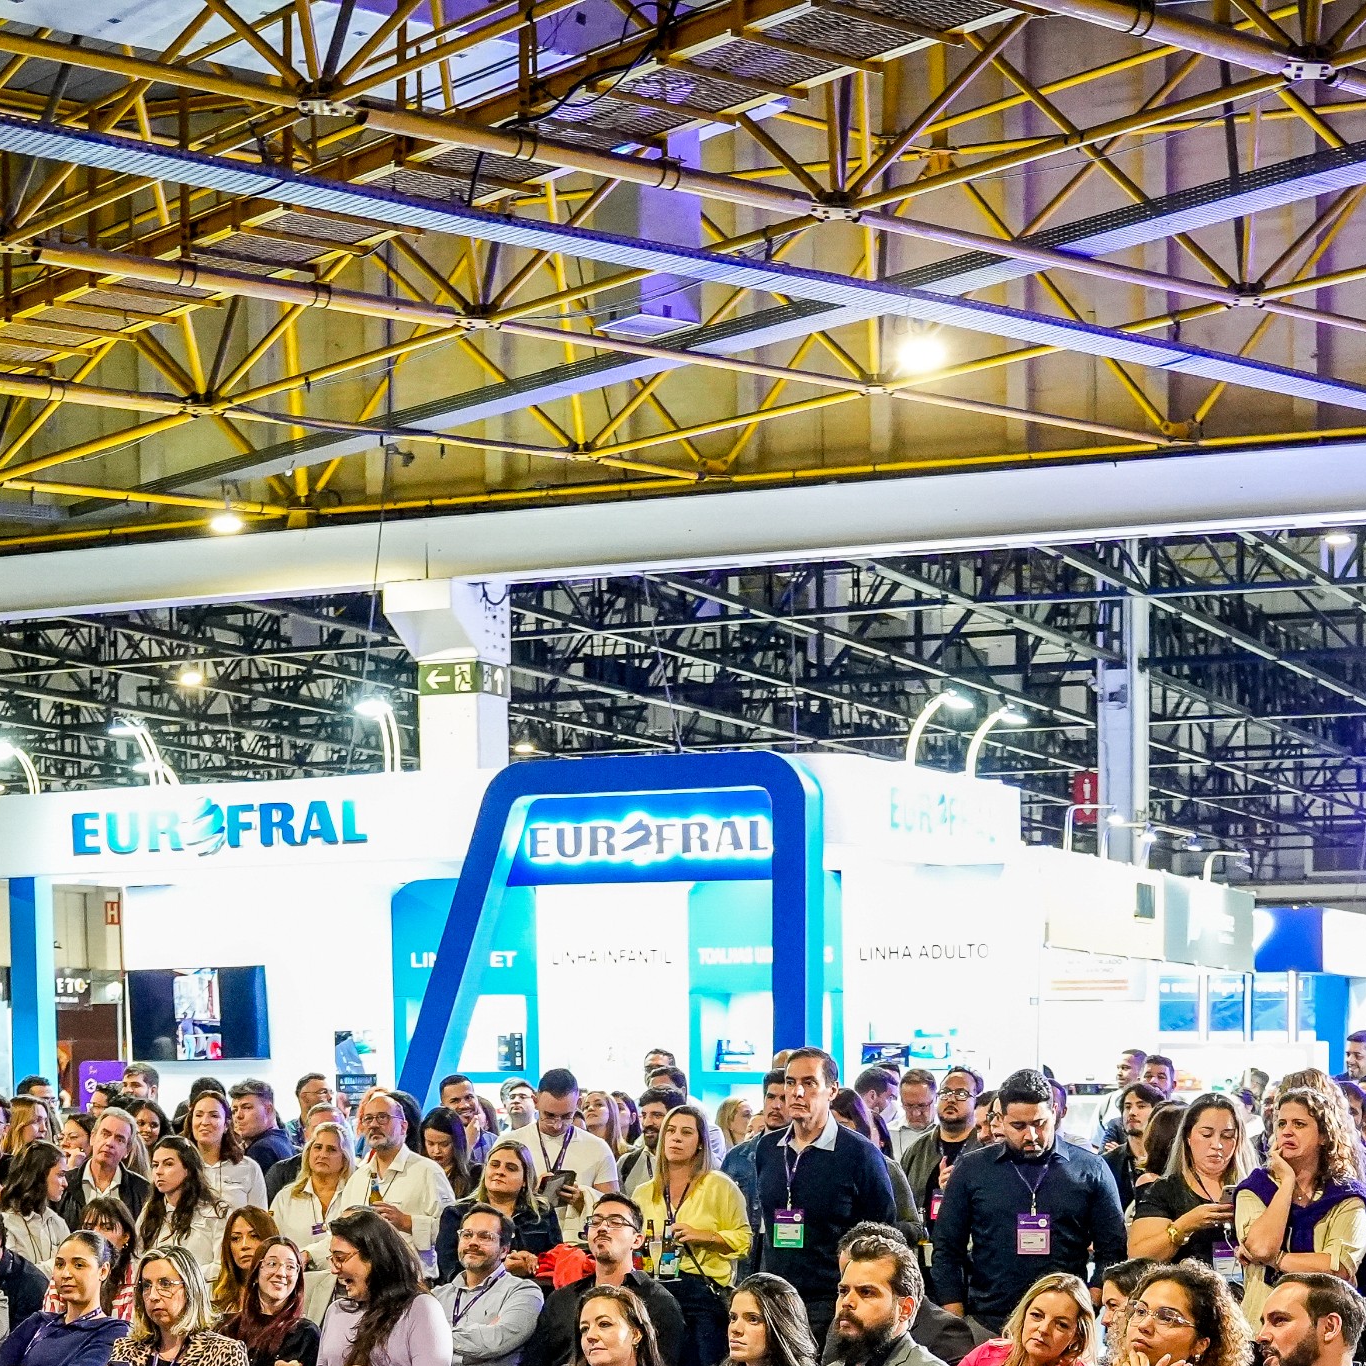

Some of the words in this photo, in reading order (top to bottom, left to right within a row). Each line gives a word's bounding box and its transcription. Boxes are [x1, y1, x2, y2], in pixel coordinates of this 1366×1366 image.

[72, 797, 367, 857] EUROFRAL
[529, 812, 770, 860] EUROFRAL
[411, 951, 437, 968] LIN
[490, 951, 517, 967] ET
[859, 946, 912, 961] LINHA
[919, 944, 989, 960] ADULTO
